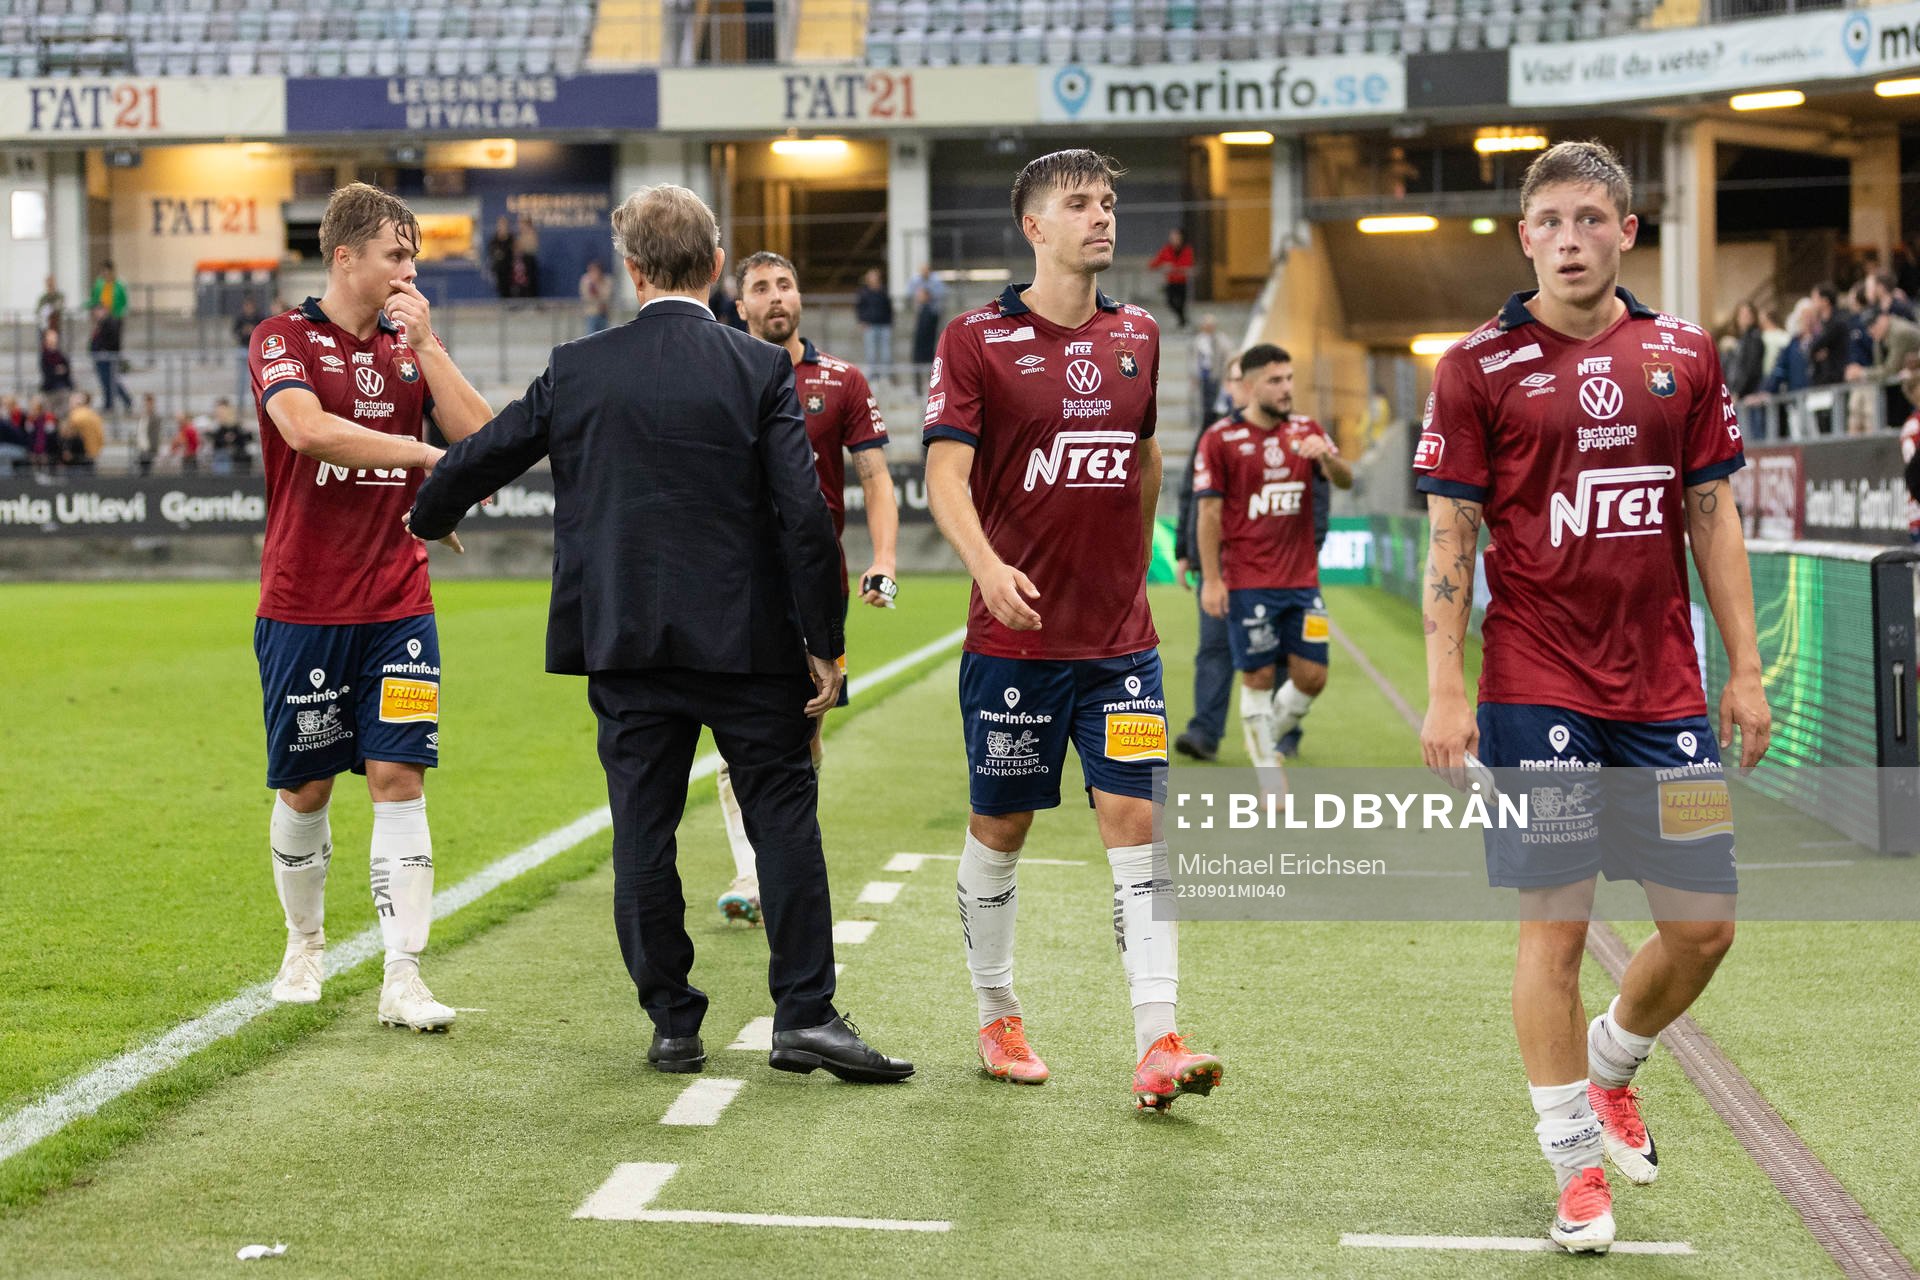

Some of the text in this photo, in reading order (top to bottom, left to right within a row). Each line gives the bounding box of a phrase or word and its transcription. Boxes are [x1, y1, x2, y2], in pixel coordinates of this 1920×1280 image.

[1582, 55, 1617, 81] vill
[386, 75, 557, 104] LEGENDENS
[782, 71, 916, 120] FAT21
[1106, 66, 1388, 113] merinfo.se
[28, 83, 161, 131] FAT21
[405, 102, 540, 129] UTVALDA
[150, 197, 260, 235] FAT21
[262, 362, 301, 381] UNIBET
[1021, 366, 1046, 375] umbro
[1577, 356, 1613, 375] NTEX
[1526, 386, 1556, 398] umbro
[354, 399, 395, 413] factoring
[1062, 397, 1112, 411] factoring
[1062, 406, 1110, 419] gruppen.
[353, 407, 392, 419] gruppen.
[1577, 423, 1638, 439] factoring
[1578, 436, 1635, 452] gruppen.
[1023, 430, 1137, 492] NTEX
[0, 491, 147, 524] mla Ullevi
[160, 490, 266, 523] Gamla
[1550, 465, 1676, 548] NTEX
[286, 685, 350, 705] merinfo.se
[387, 685, 437, 702] TRIUMF
[394, 699, 430, 711] GLASS
[1103, 695, 1165, 713] merinfo.se
[980, 708, 1053, 725] merinfo.se
[297, 724, 343, 744] STIFTELSEN
[1111, 721, 1164, 737] TRIUMF
[289, 730, 354, 753] DUNROSS&CO
[1120, 735, 1159, 748] GLASS
[985, 757, 1040, 767] STIFTELSEN
[976, 765, 1050, 777] DUNROSS&CO
[1678, 808, 1725, 821] GLASS
[1531, 818, 1594, 832] STIFTELSEN
